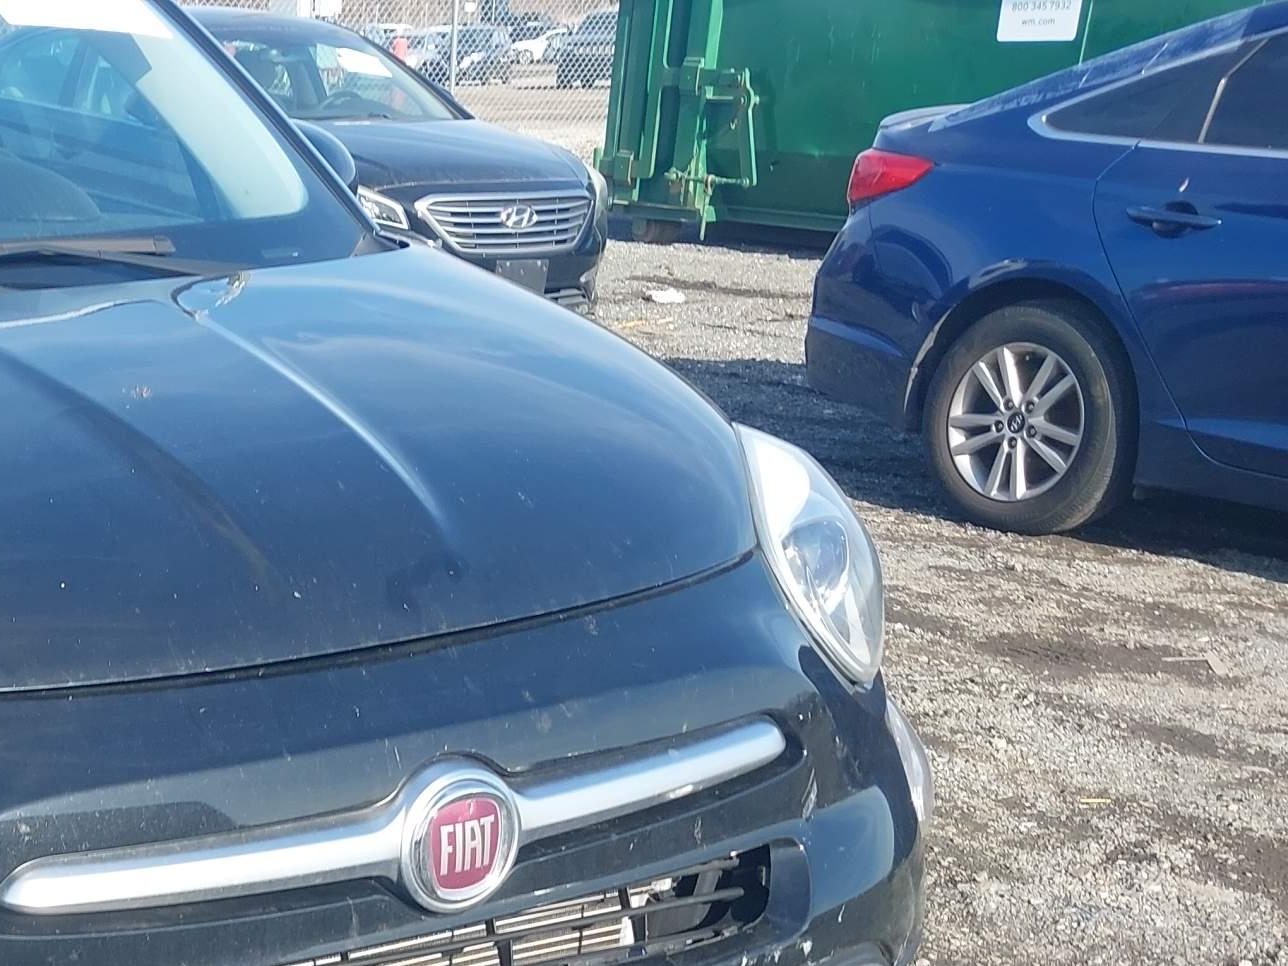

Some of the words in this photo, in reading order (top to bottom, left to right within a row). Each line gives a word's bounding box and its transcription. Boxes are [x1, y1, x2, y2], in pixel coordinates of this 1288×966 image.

[1012, 2, 1029, 11] 800
[1031, 1, 1048, 10] 345
[1050, 0, 1072, 9] 7932
[440, 815, 494, 876] FIAT
